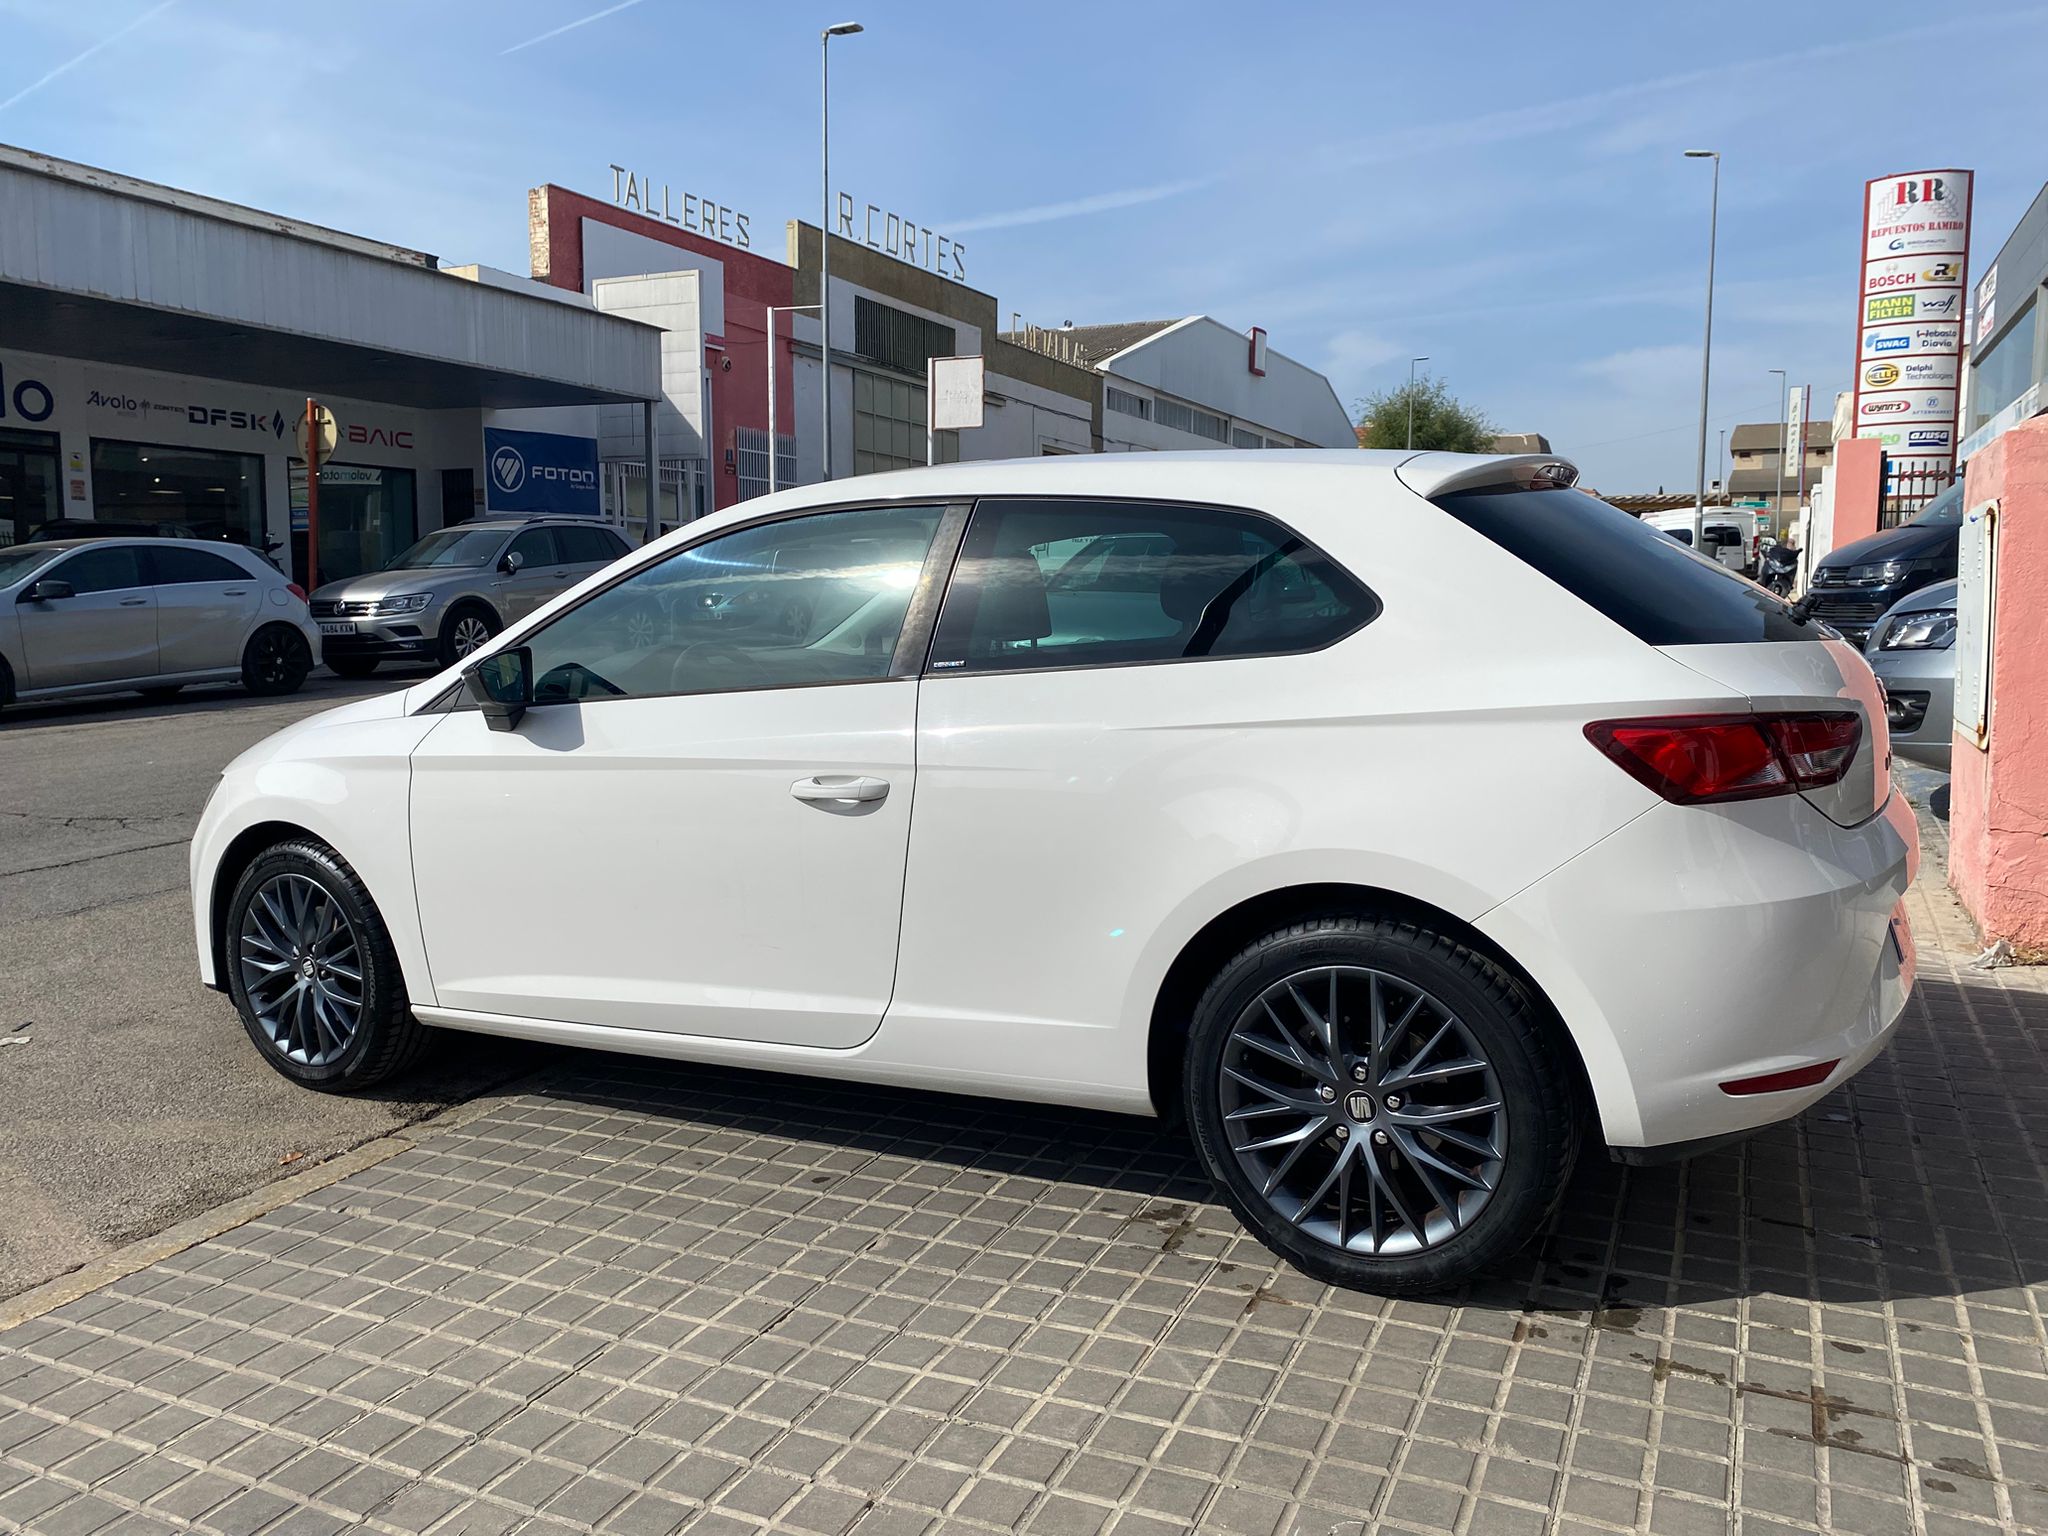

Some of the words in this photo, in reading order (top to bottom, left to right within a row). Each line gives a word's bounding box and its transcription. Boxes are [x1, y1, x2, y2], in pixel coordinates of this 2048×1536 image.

[609, 163, 750, 249] TALLERES
[1871, 223, 1925, 238] REPUESTOS
[1929, 221, 1964, 231] RAMIRO
[1869, 272, 1916, 289] BOSCH
[1870, 296, 1913, 310] MANN
[1869, 306, 1912, 320] FILTER
[1876, 339, 1907, 349] SWAG
[1868, 370, 1898, 379] HELLA
[1906, 364, 1933, 372] Delphi
[1906, 372, 1953, 380] Technologies
[188, 405, 267, 432] DFSK
[348, 425, 413, 449] BAIC
[532, 466, 594, 482] FOTON
